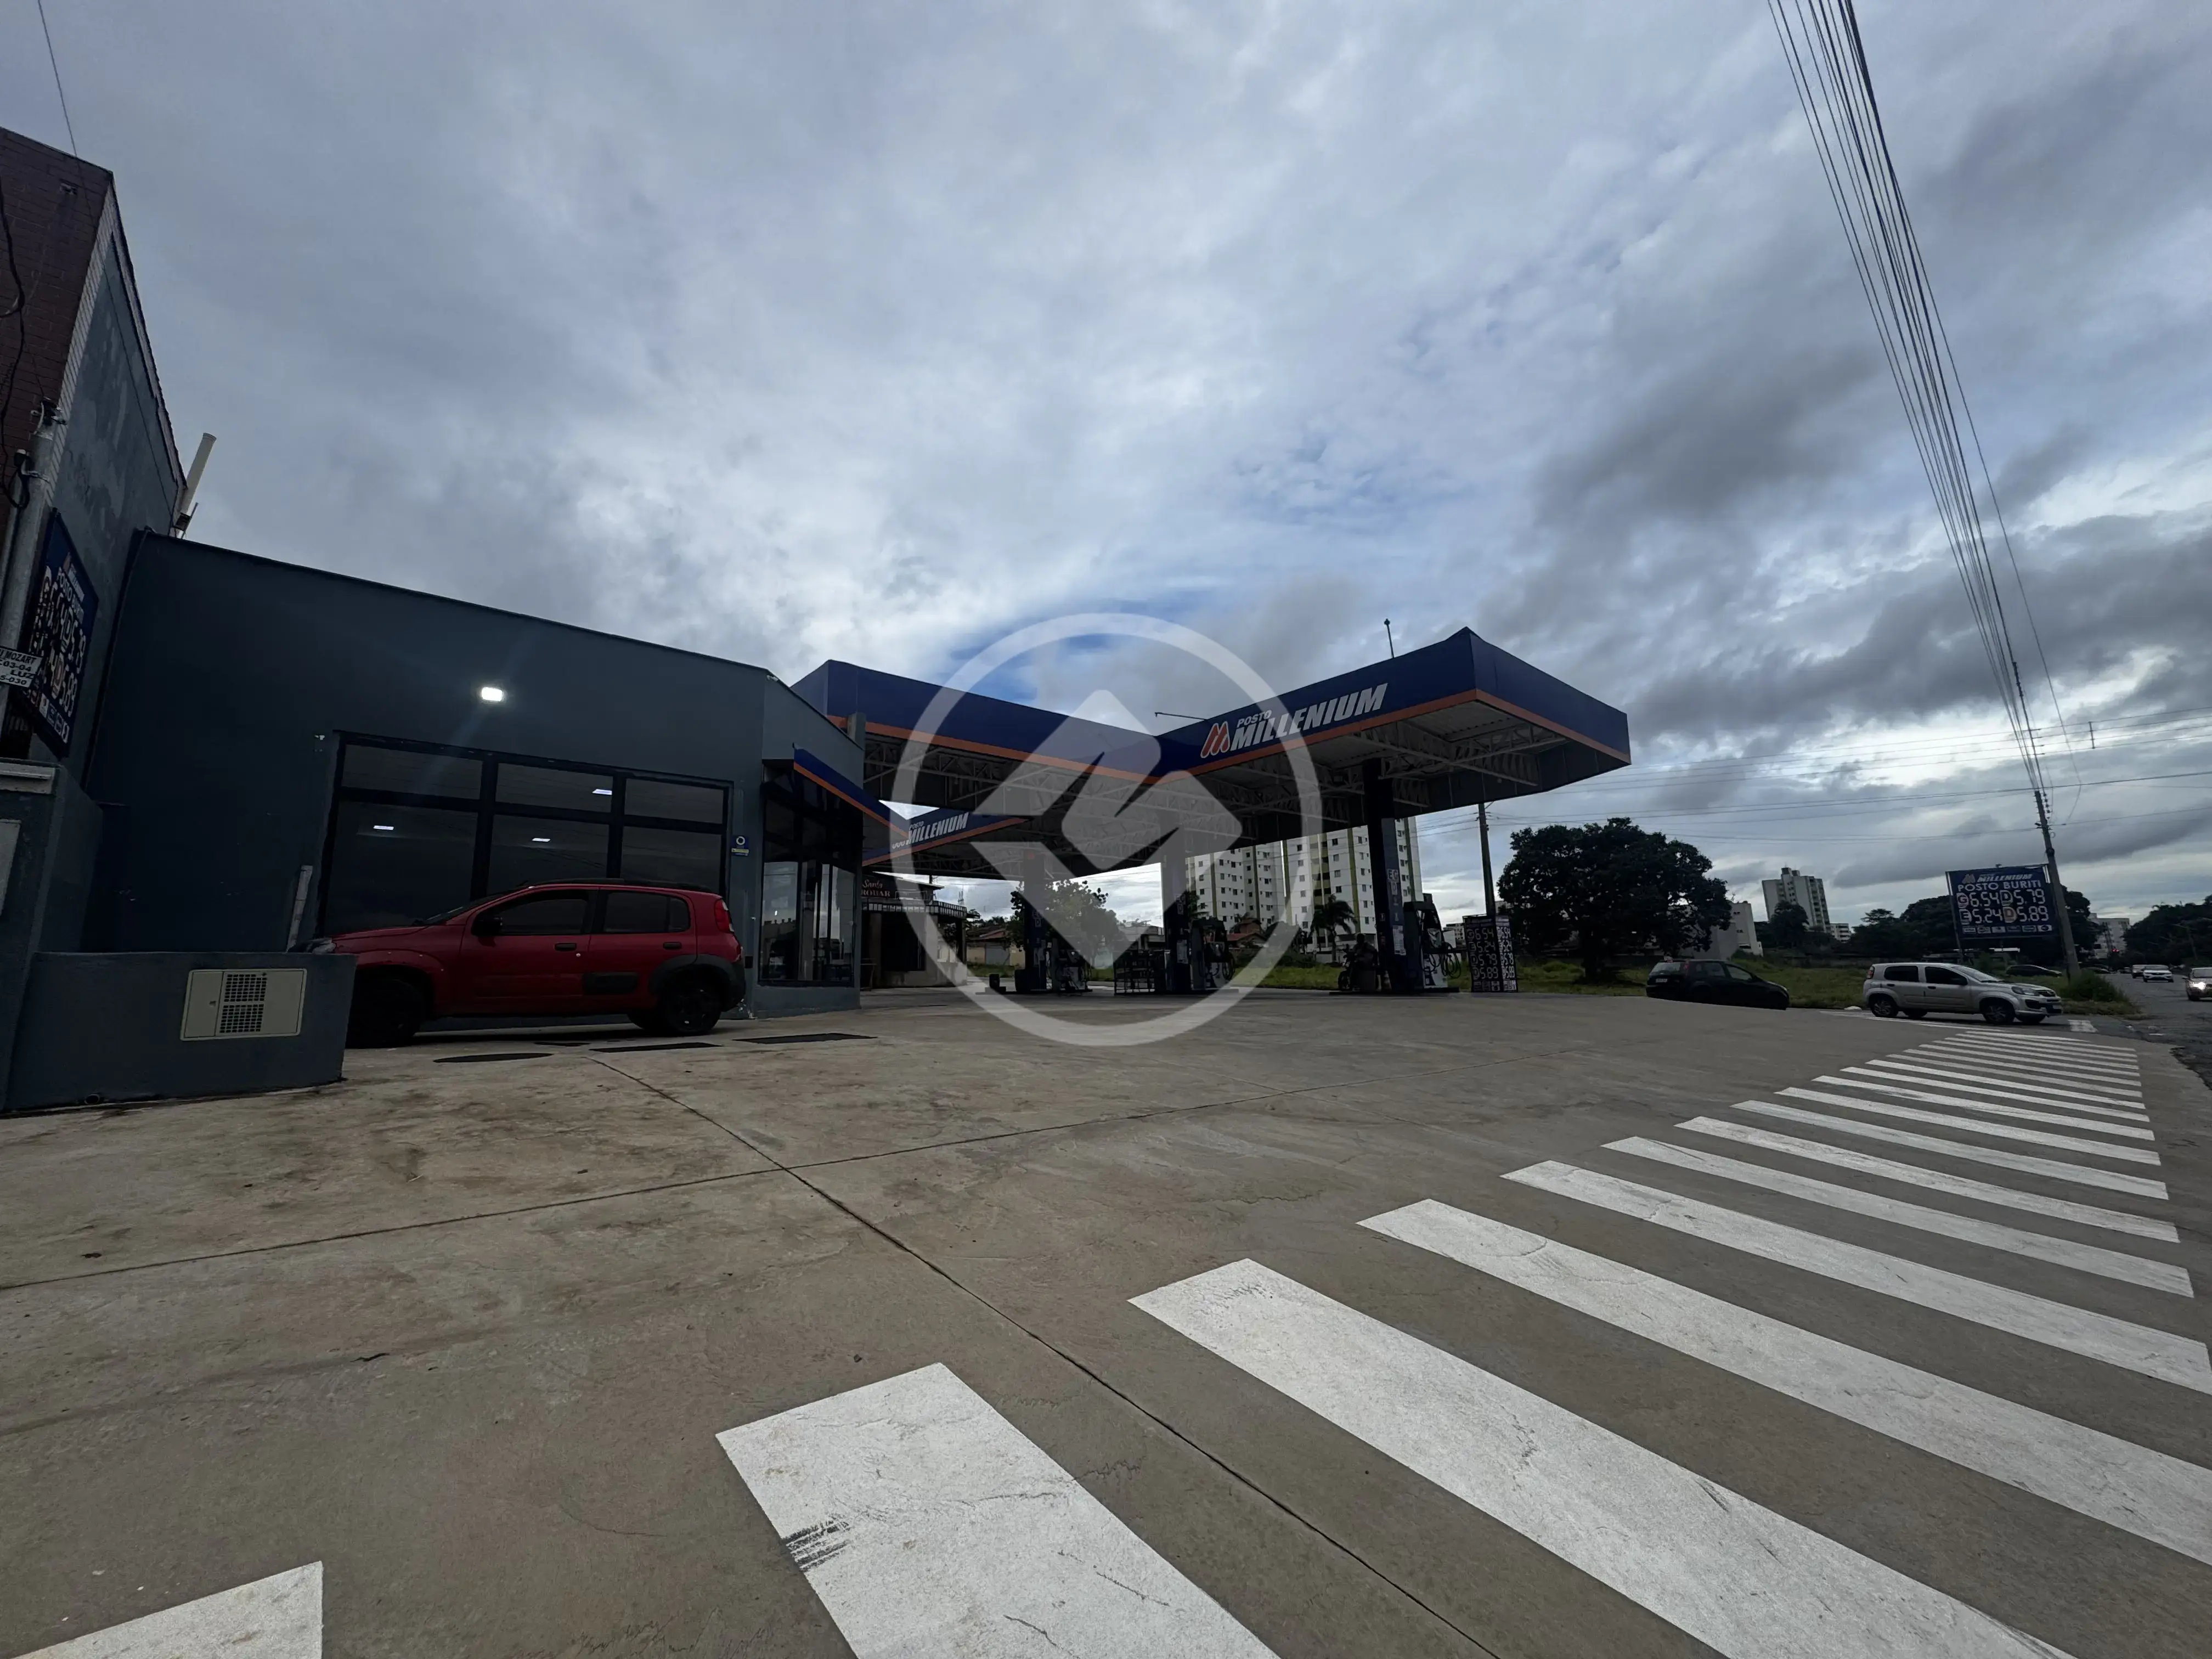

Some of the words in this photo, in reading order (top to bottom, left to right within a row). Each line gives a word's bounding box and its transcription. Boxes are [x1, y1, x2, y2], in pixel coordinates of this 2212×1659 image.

[10, 670, 36, 680] LUZ
[1230, 682, 1388, 752] MILLENIUM
[1237, 710, 1272, 728] POSTO
[906, 812, 969, 845] MILLENIUM
[909, 821, 924, 831] POSTO
[1958, 883, 1999, 891] POSTO
[2003, 880, 2041, 889] BURITI
[1970, 891, 2000, 907] 6.54
